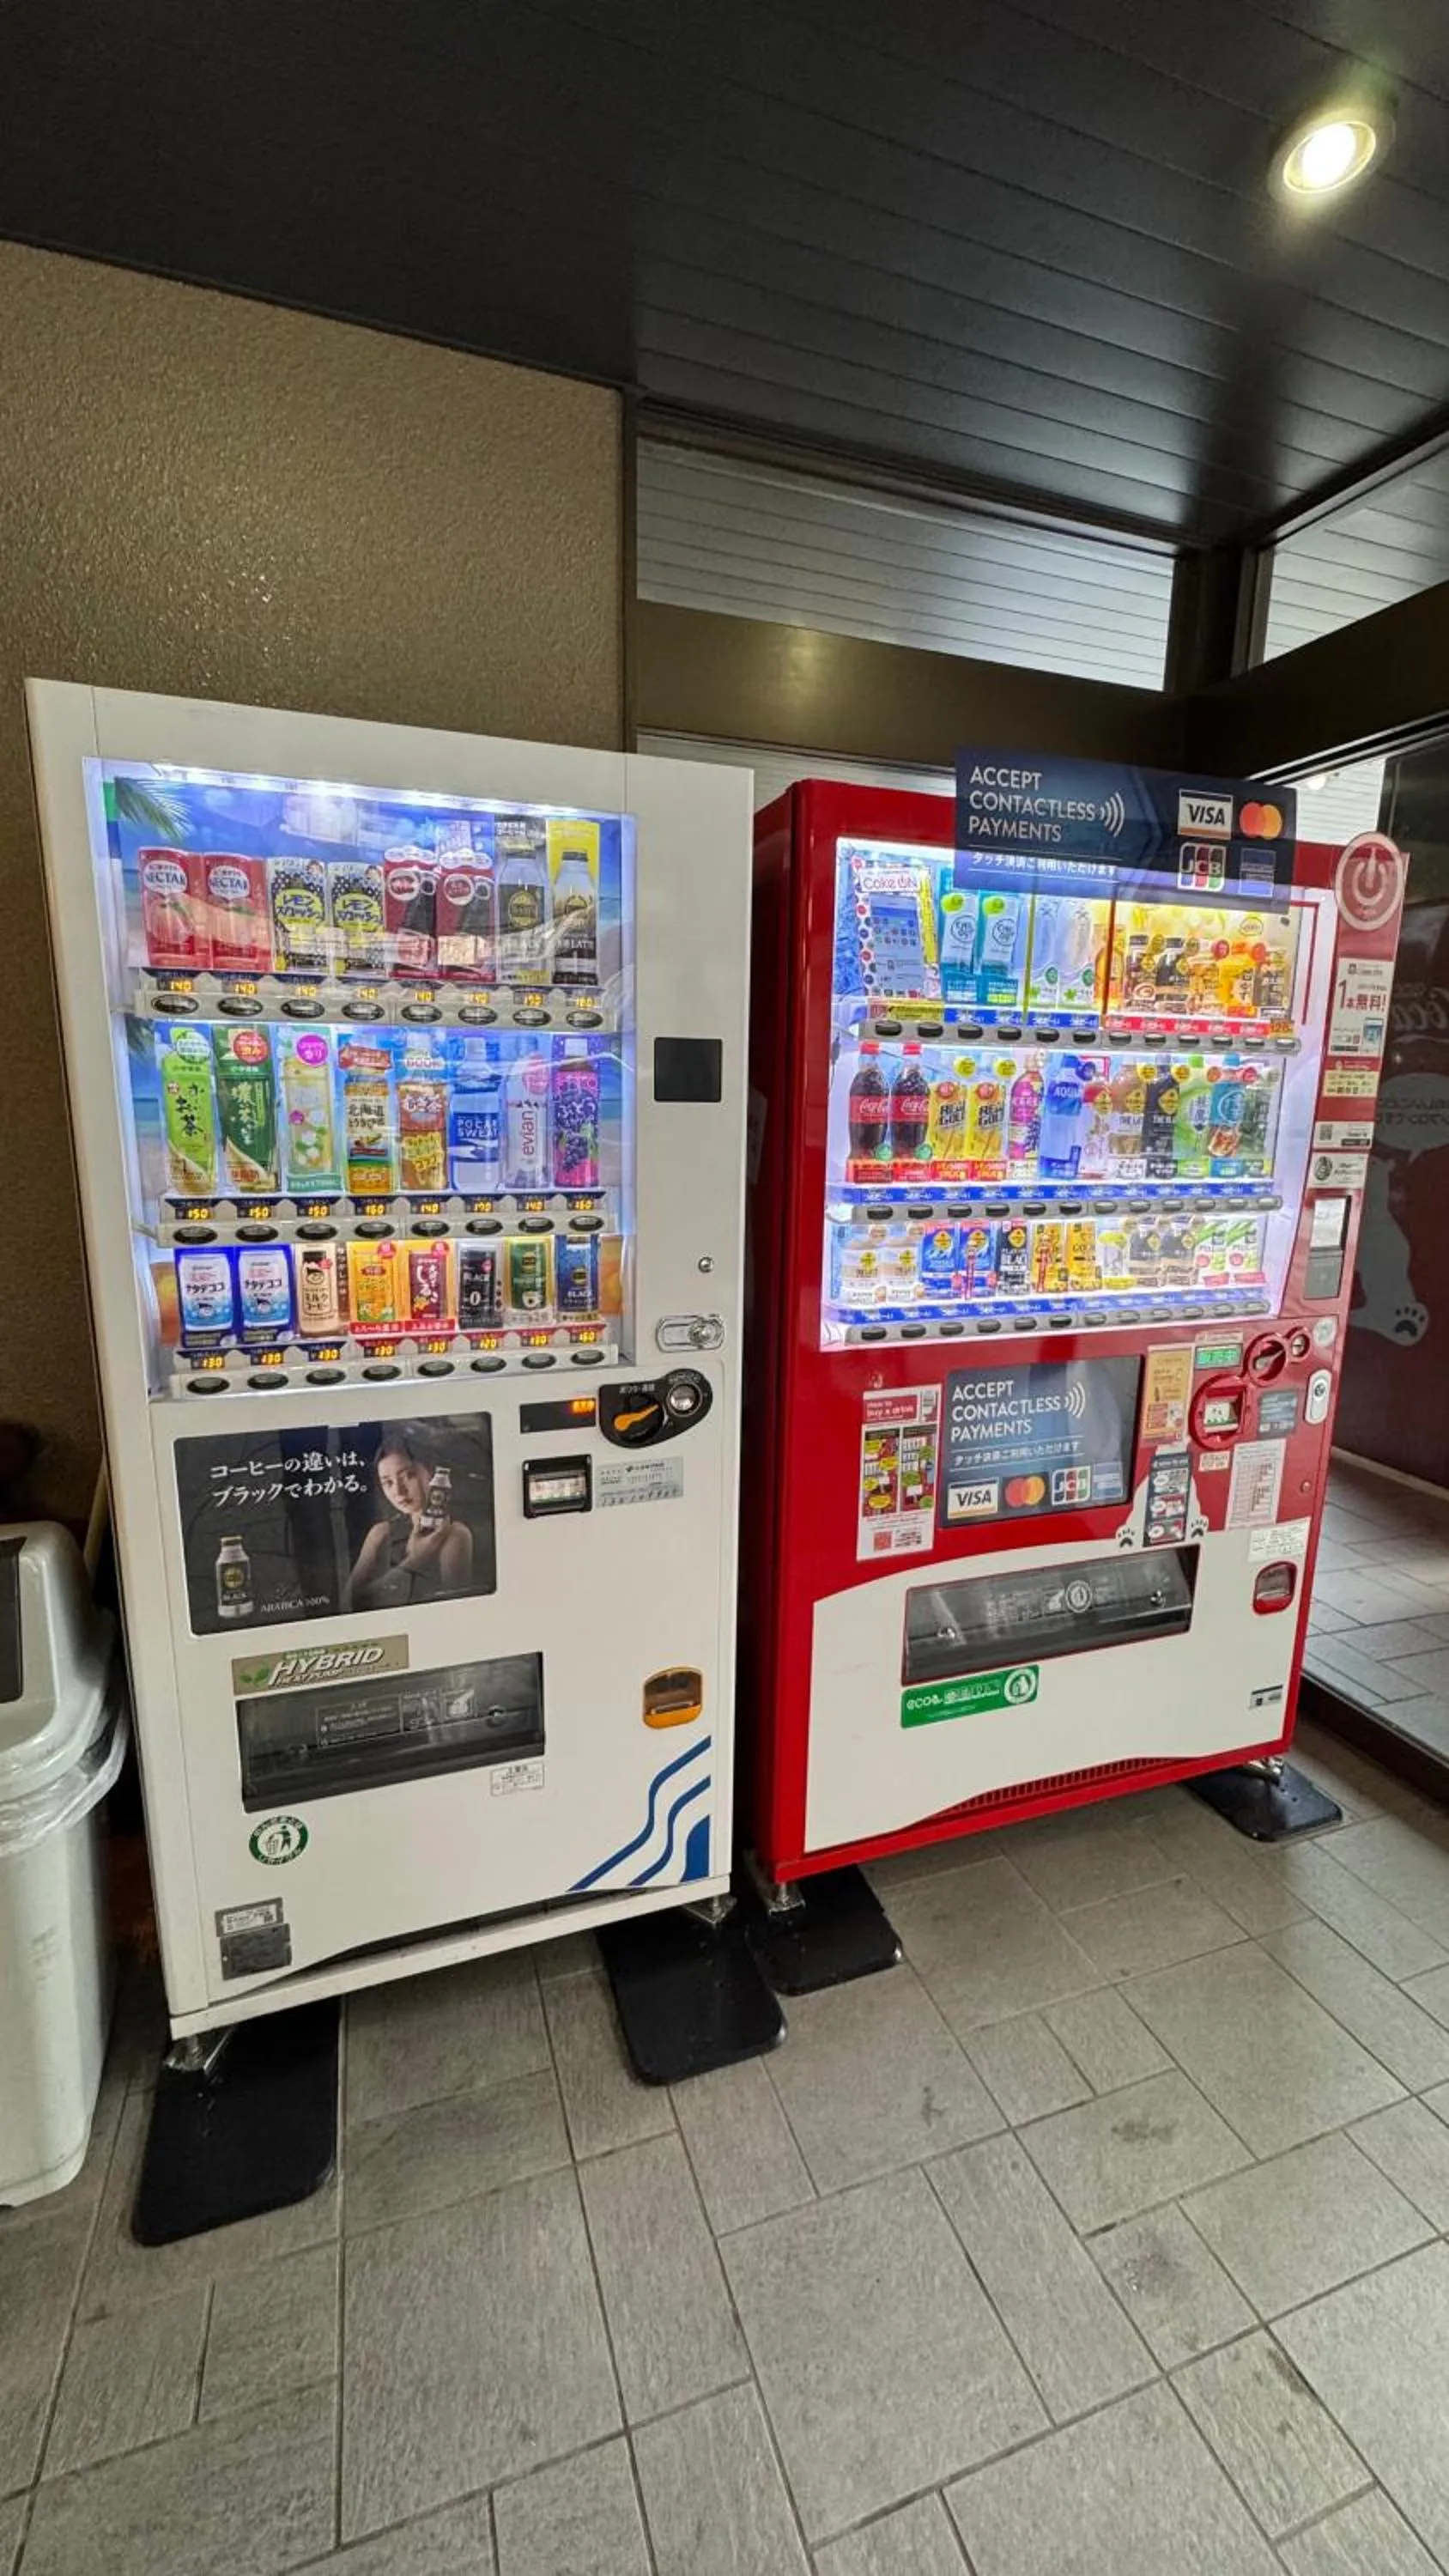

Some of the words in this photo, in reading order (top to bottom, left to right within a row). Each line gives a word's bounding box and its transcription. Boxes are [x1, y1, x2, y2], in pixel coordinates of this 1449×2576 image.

[970, 766, 1042, 791] ACCEPT
[970, 790, 1095, 821] CONTACTLESS
[1187, 802, 1226, 827] VISA
[968, 815, 1062, 842] PAYMENTS
[1184, 857, 1223, 877] JCB
[458, 1119, 497, 1128] POCAR
[521, 1109, 535, 1157] evian
[188, 1208, 209, 1219] 150
[249, 1206, 269, 1218] 150
[952, 1379, 1014, 1401] ACCEPT
[952, 1395, 1061, 1421] CONTACTLESS
[951, 1419, 1033, 1443] PAYMENTS
[210, 1451, 366, 1479] コーヒーの違いは、
[213, 1474, 368, 1508] ブラックでわかる。
[1054, 1477, 1087, 1492] JCB
[956, 1490, 991, 1507] VISA
[269, 1647, 385, 1686] HYBRID
